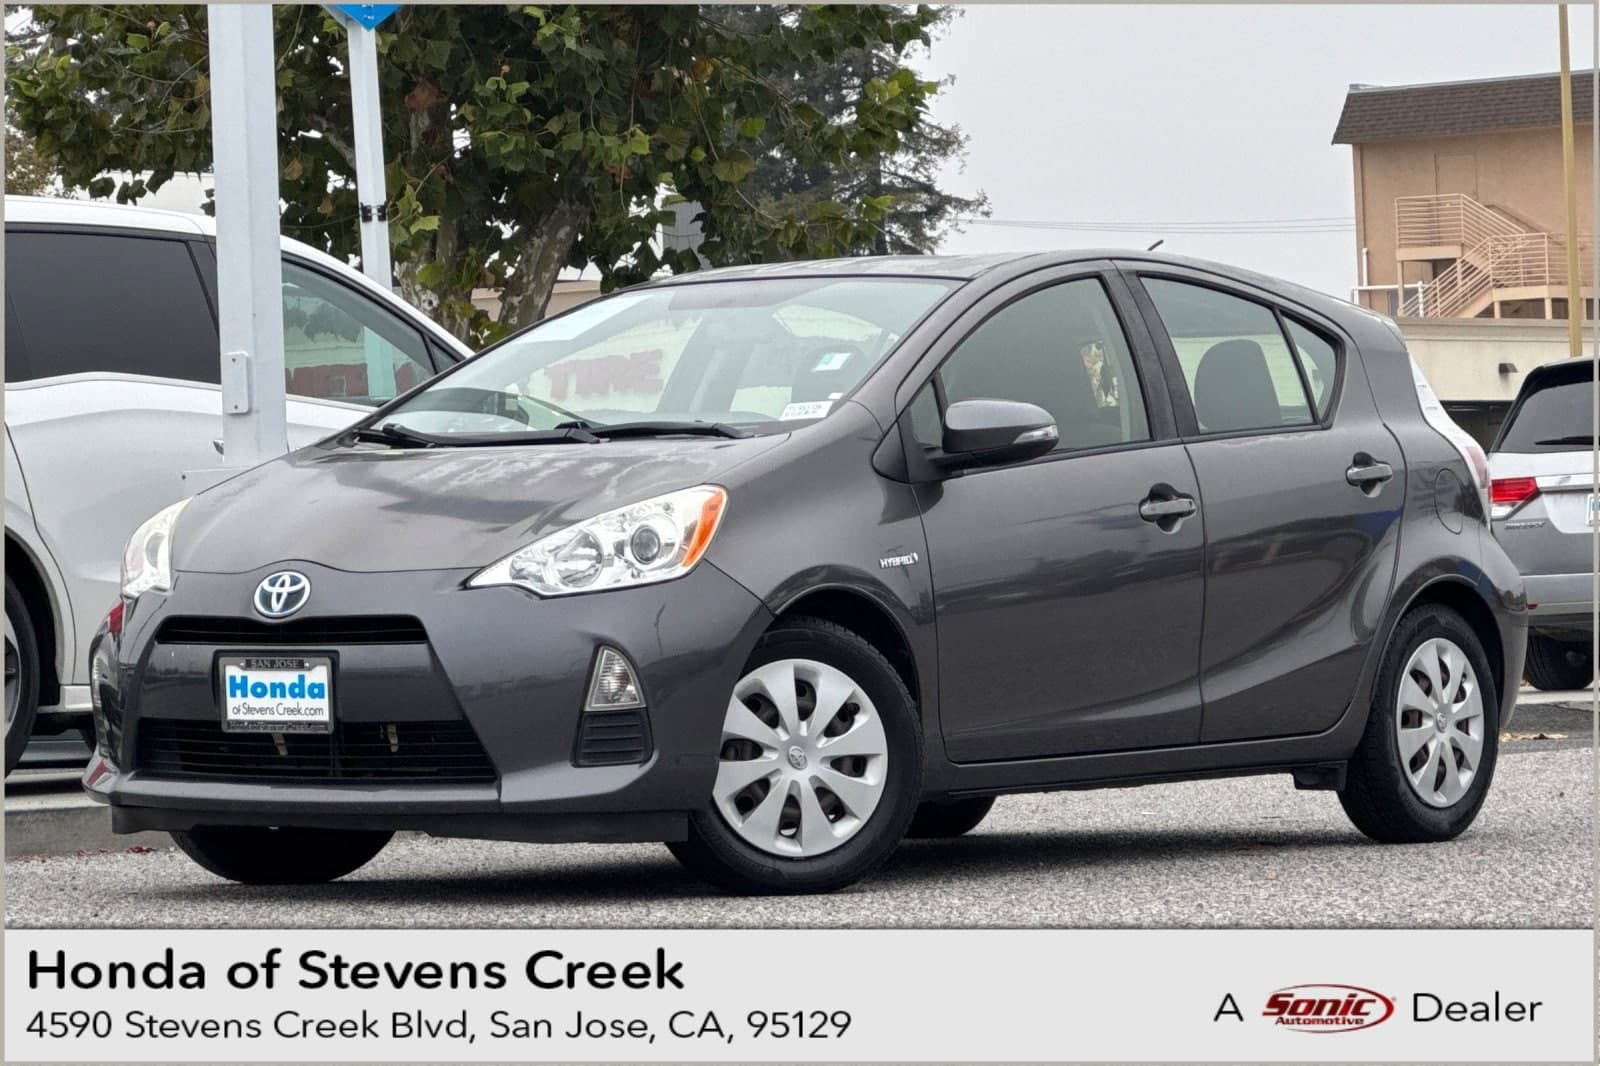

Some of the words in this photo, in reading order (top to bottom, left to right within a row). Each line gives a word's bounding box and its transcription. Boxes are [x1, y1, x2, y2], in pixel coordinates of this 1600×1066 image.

[880, 554, 914, 568] HYBRID
[274, 659, 298, 668] JOSE
[229, 674, 325, 699] Honda
[232, 703, 241, 715] of
[242, 703, 275, 716] Stevens
[276, 702, 324, 716] Creek.com
